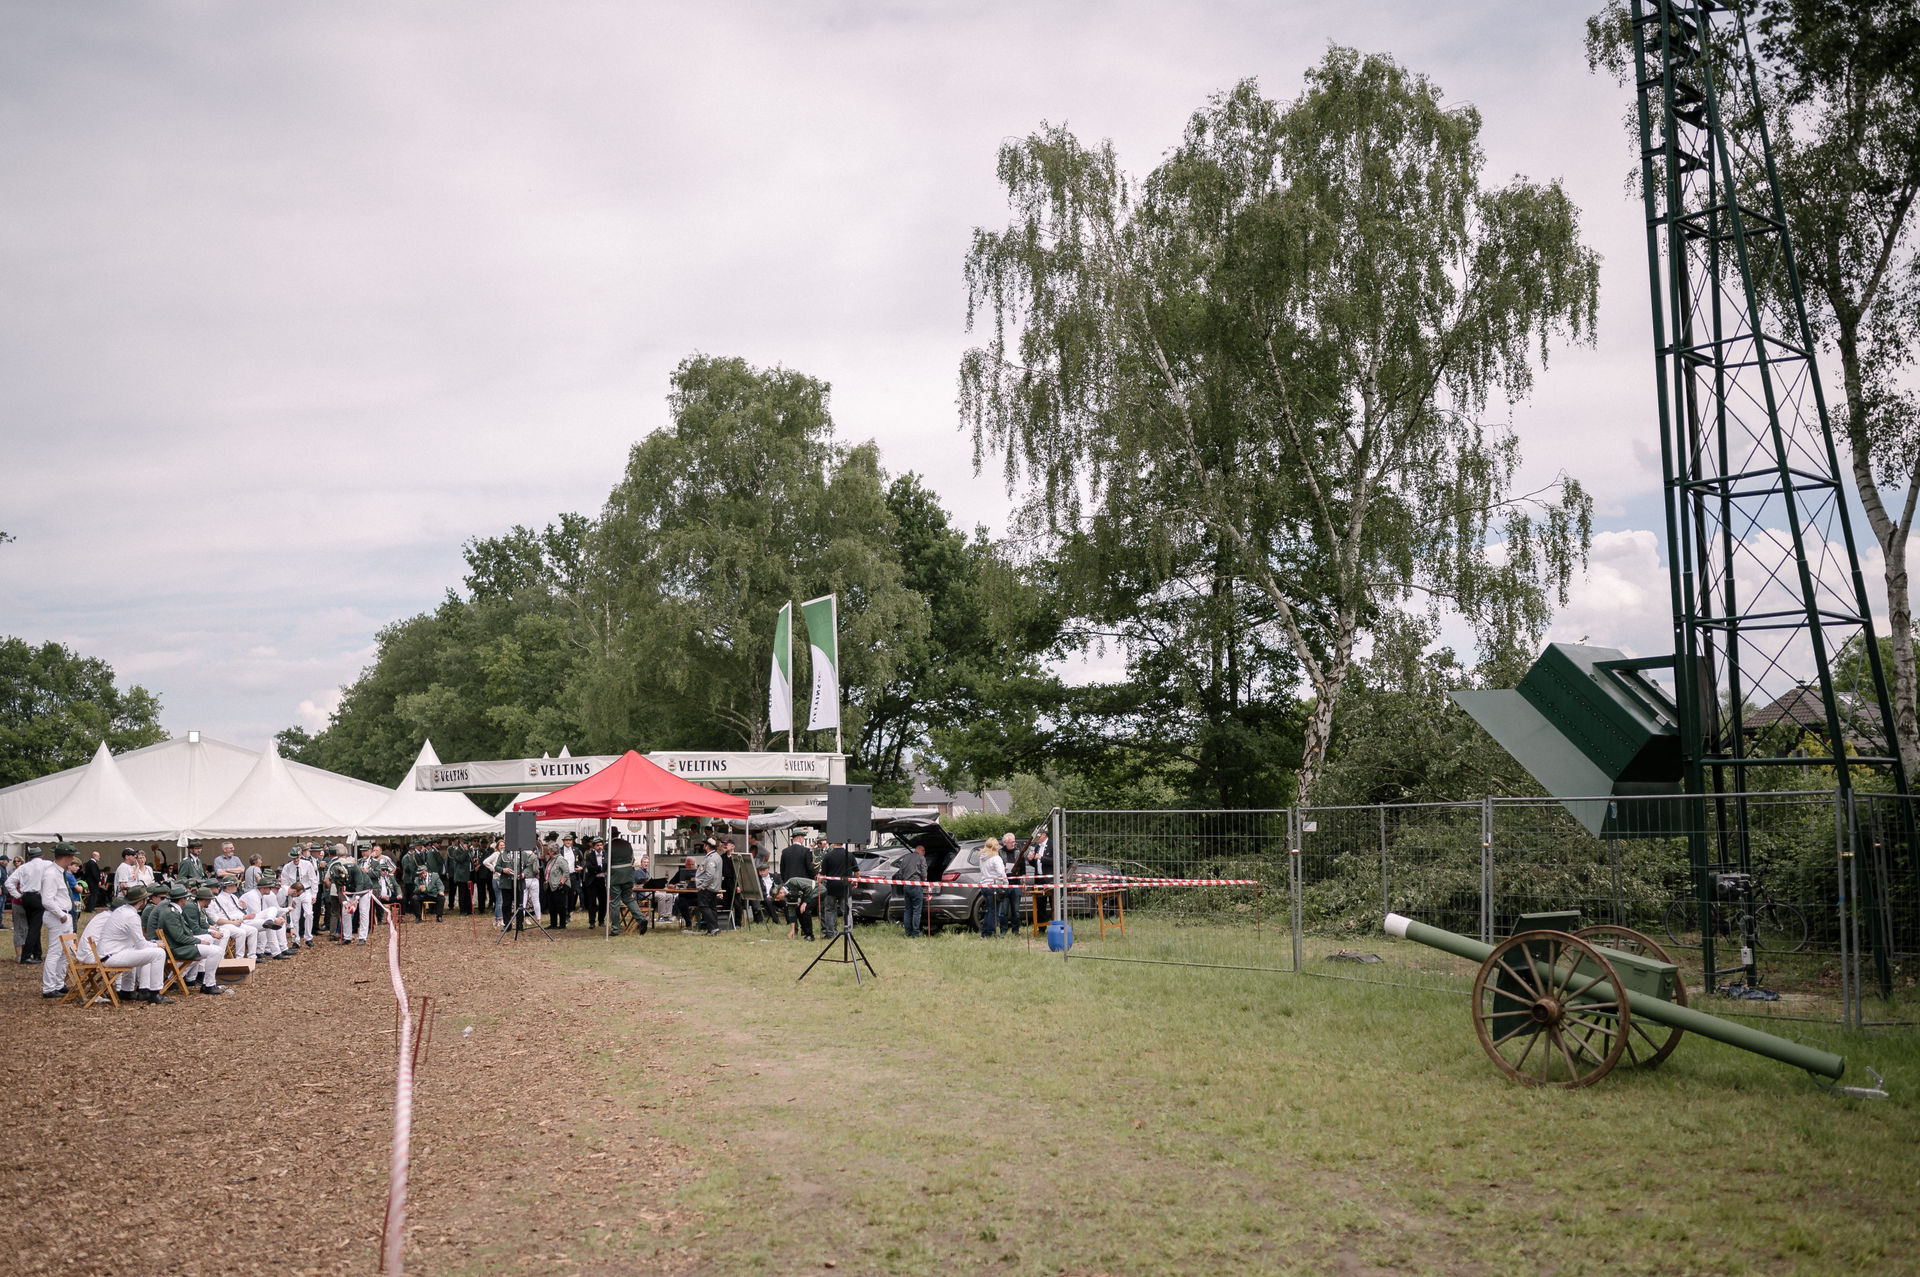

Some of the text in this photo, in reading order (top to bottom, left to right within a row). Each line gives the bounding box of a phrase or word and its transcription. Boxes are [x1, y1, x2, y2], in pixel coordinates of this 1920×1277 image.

[541, 763, 591, 777] VELTINS
[678, 759, 727, 772] VELTINS
[789, 759, 815, 772] VELTINS
[440, 768, 469, 782] VELTINS
